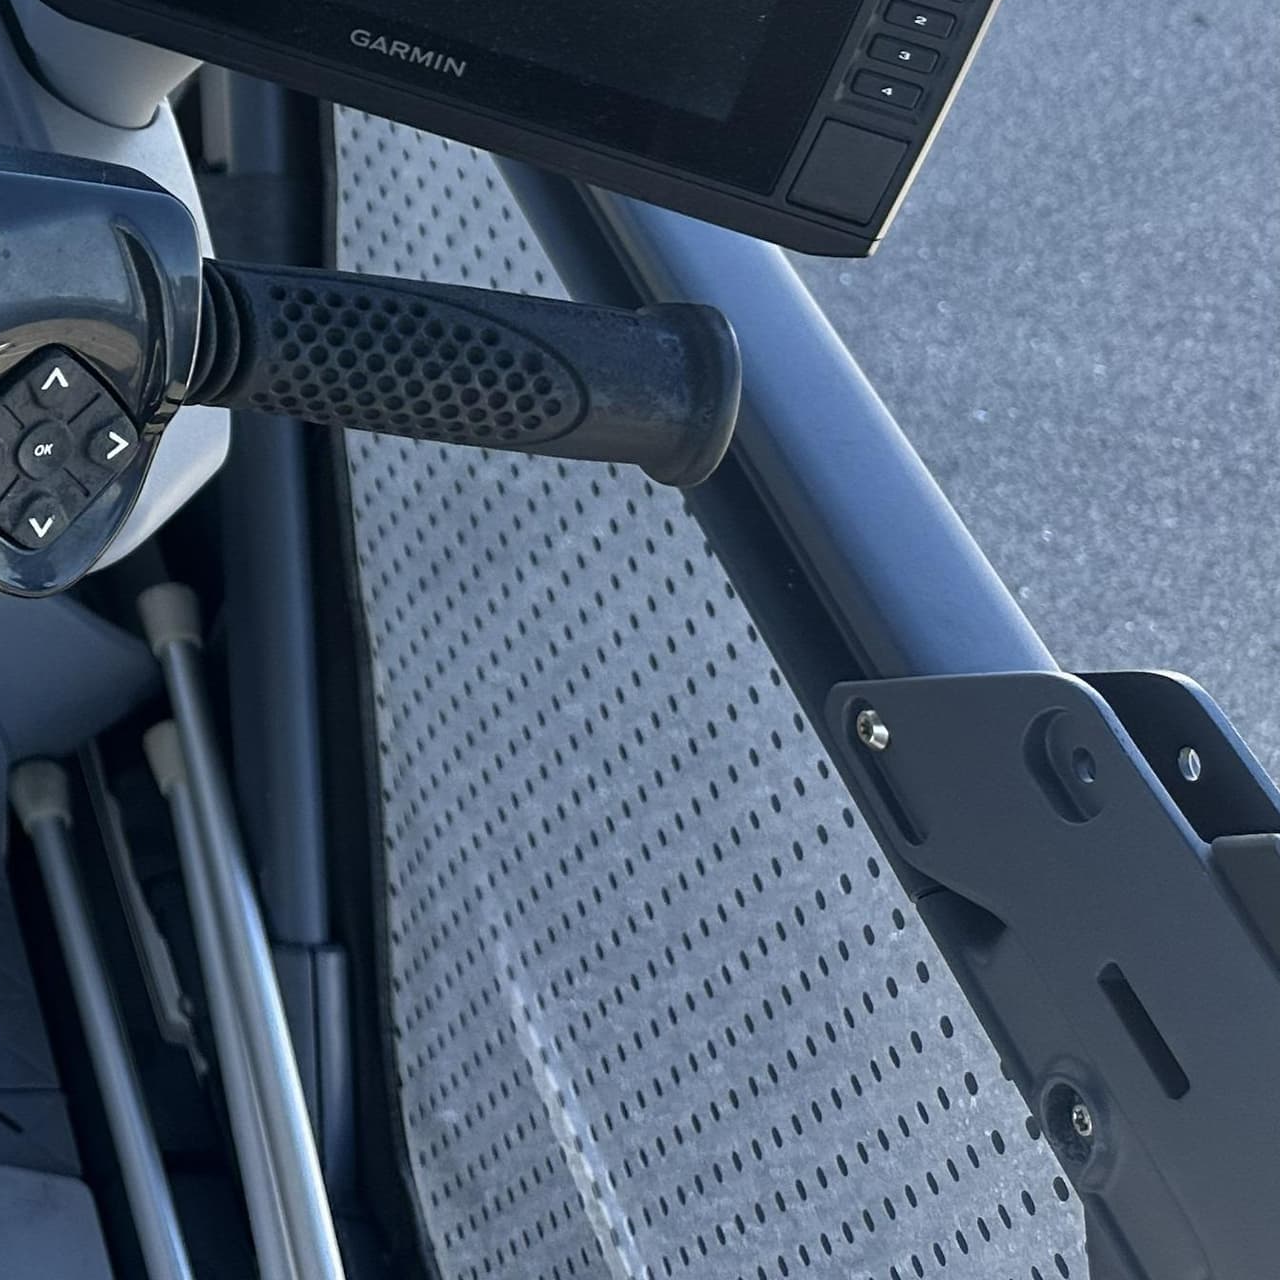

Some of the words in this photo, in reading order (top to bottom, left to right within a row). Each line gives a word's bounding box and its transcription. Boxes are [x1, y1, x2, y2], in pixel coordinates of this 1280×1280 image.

[914, 15, 928, 26] 2
[349, 28, 467, 78] GARMIN
[898, 50, 911, 61] 3
[881, 87, 893, 96] 4
[34, 443, 54, 457] OK
